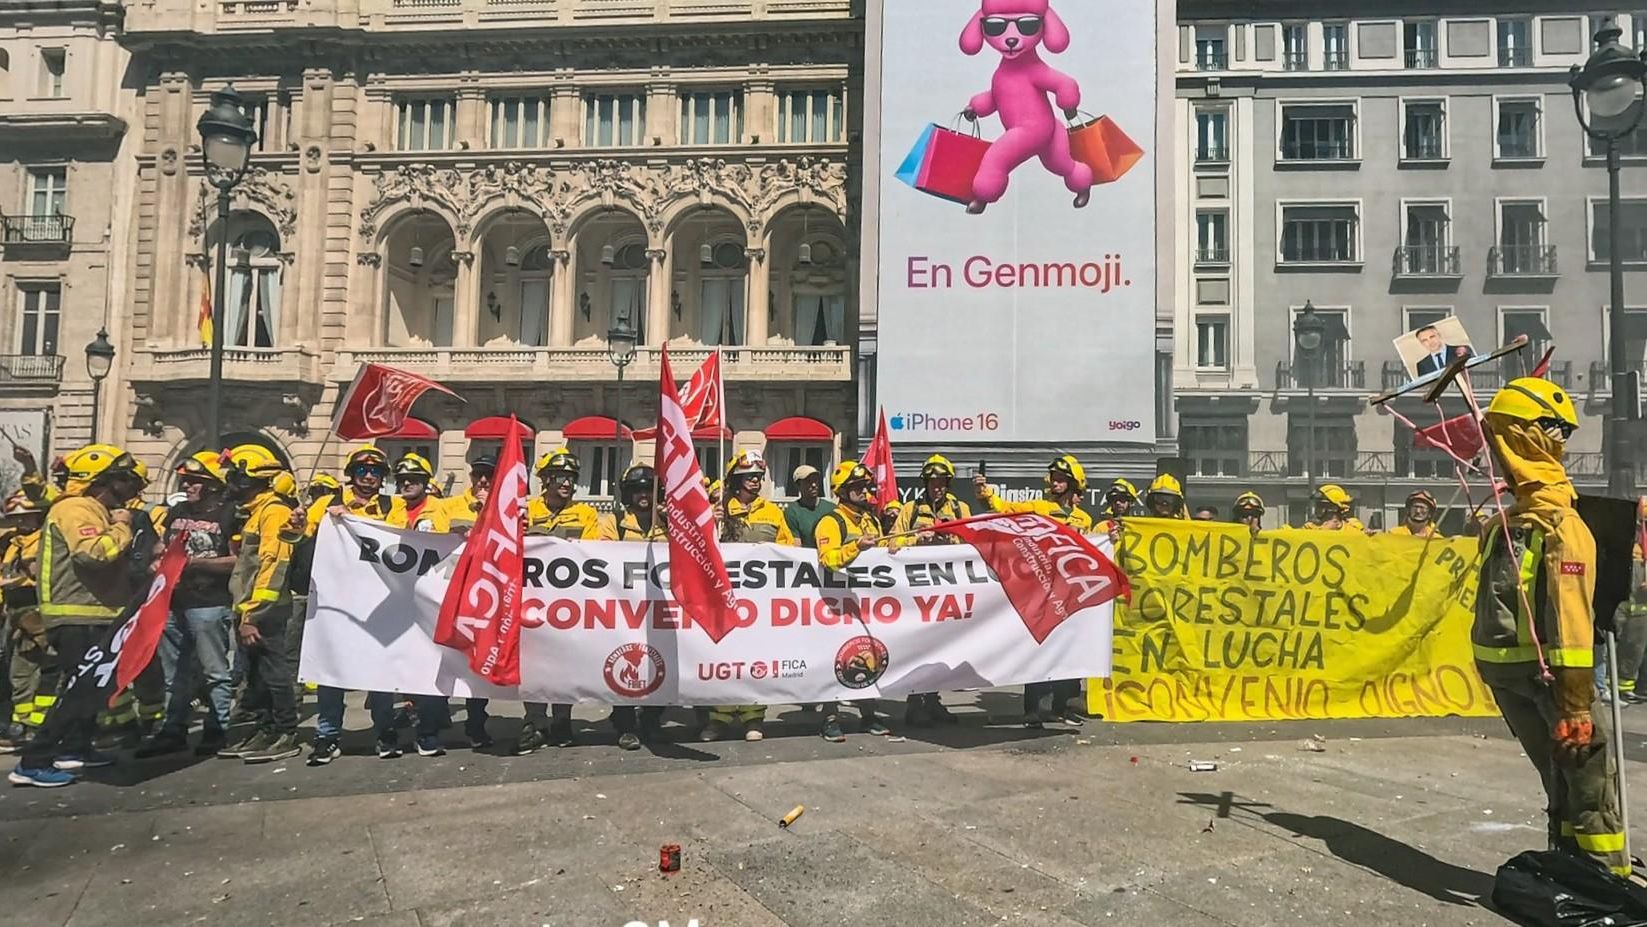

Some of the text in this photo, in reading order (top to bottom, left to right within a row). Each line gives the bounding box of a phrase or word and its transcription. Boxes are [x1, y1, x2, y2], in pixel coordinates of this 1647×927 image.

[907, 253, 1131, 293] En Genmoji.
[906, 413, 998, 431] iPhone 16
[1109, 420, 1140, 430] yoigo
[623, 560, 896, 589] FOESTALES
[905, 562, 959, 587] EN
[1118, 531, 1350, 589] BOMBEROS
[520, 598, 758, 630] CONVEO
[771, 596, 900, 626] DIGNO
[913, 593, 974, 622] YA!
[1204, 630, 1324, 669] LUCHA
[698, 660, 807, 681] UGT FICA
